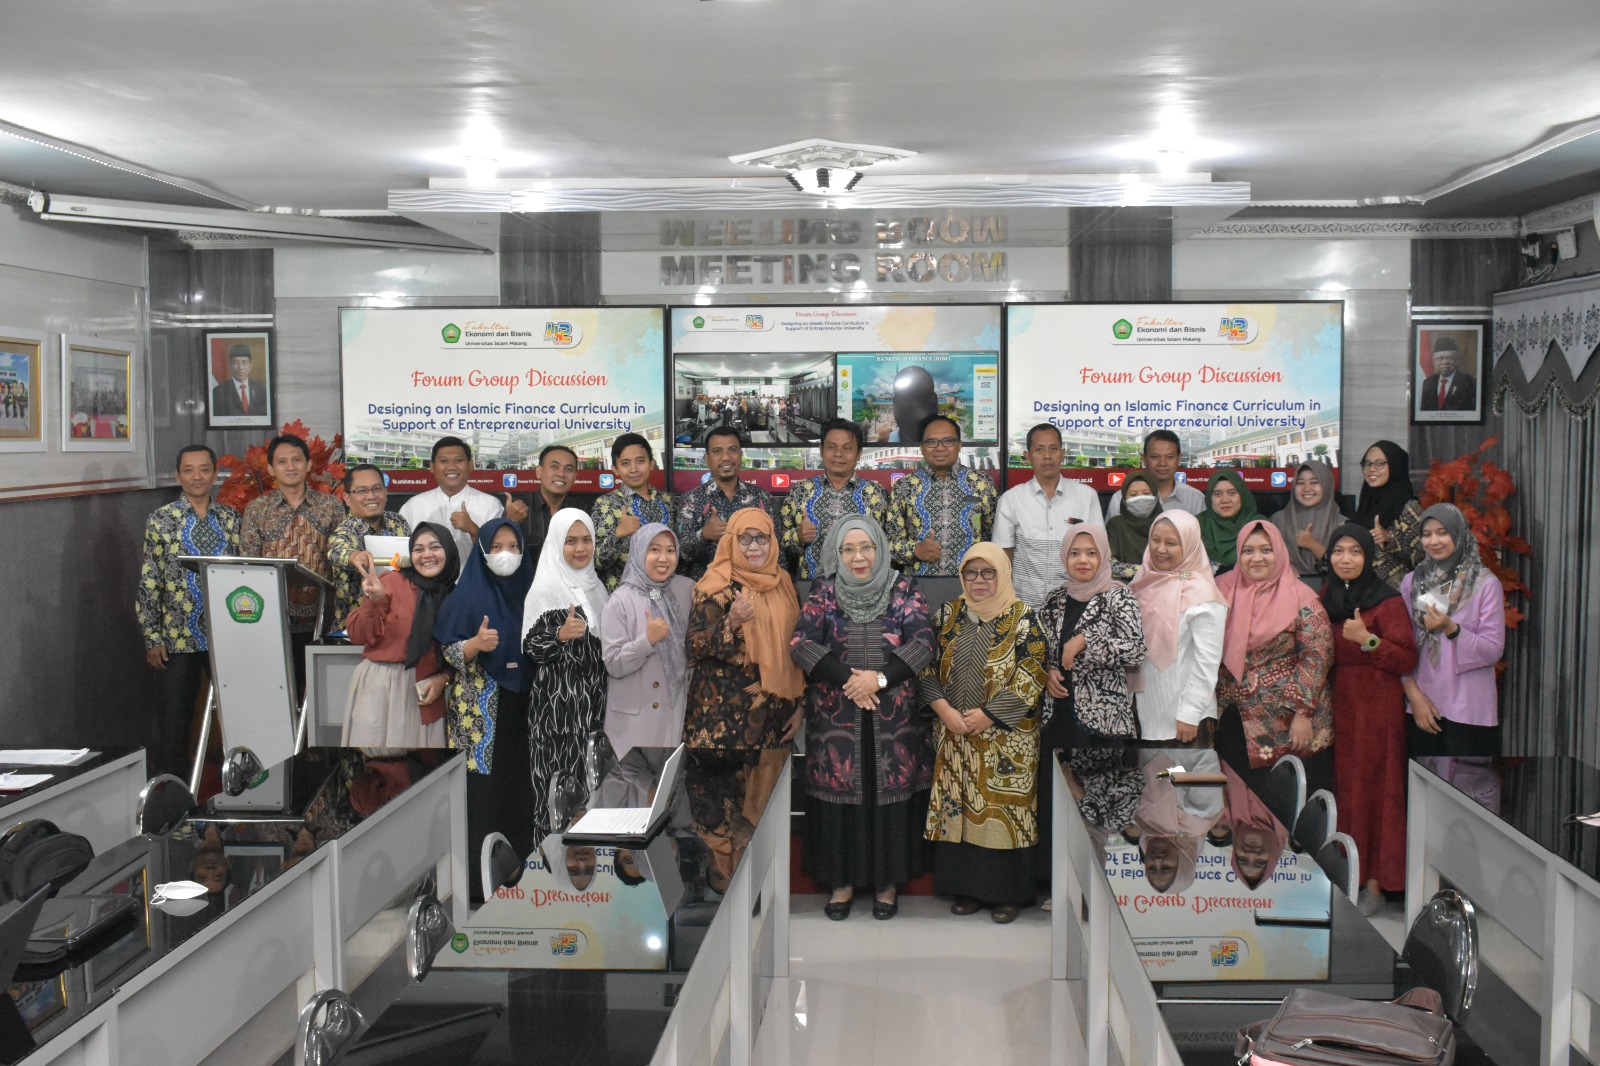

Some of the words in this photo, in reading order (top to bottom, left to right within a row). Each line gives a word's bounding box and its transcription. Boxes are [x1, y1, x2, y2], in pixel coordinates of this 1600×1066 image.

[660, 253, 861, 285] MEETING
[876, 251, 1007, 283] ROOM
[464, 321, 511, 330] Fakultas
[1136, 317, 1184, 326] Fakultas
[412, 370, 465, 387] Forum
[468, 369, 520, 394] Group
[526, 368, 608, 387] Discussion
[1079, 367, 1135, 384] Forum
[1139, 366, 1193, 391] Group
[1198, 364, 1284, 383] Discussion
[368, 403, 432, 417] Designing
[436, 405, 451, 415] an
[456, 403, 500, 415] Islamic
[505, 403, 556, 415] Finance
[560, 402, 630, 415] Curriculum
[634, 403, 646, 414] in
[1033, 400, 1100, 414] Designing
[1104, 402, 1121, 412] an
[1125, 400, 1171, 412] Islamic
[1176, 400, 1229, 412] Finance
[1233, 399, 1305, 412] Curriculum
[1309, 399, 1321, 411] in
[383, 419, 436, 433] Support
[440, 418, 454, 430] of
[459, 418, 560, 433] Entrepreneurial
[565, 418, 631, 433] University
[1048, 415, 1104, 430] Support
[1109, 416, 1123, 428] of
[1127, 416, 1233, 431] Entrepreneurial
[1237, 415, 1306, 430] University
